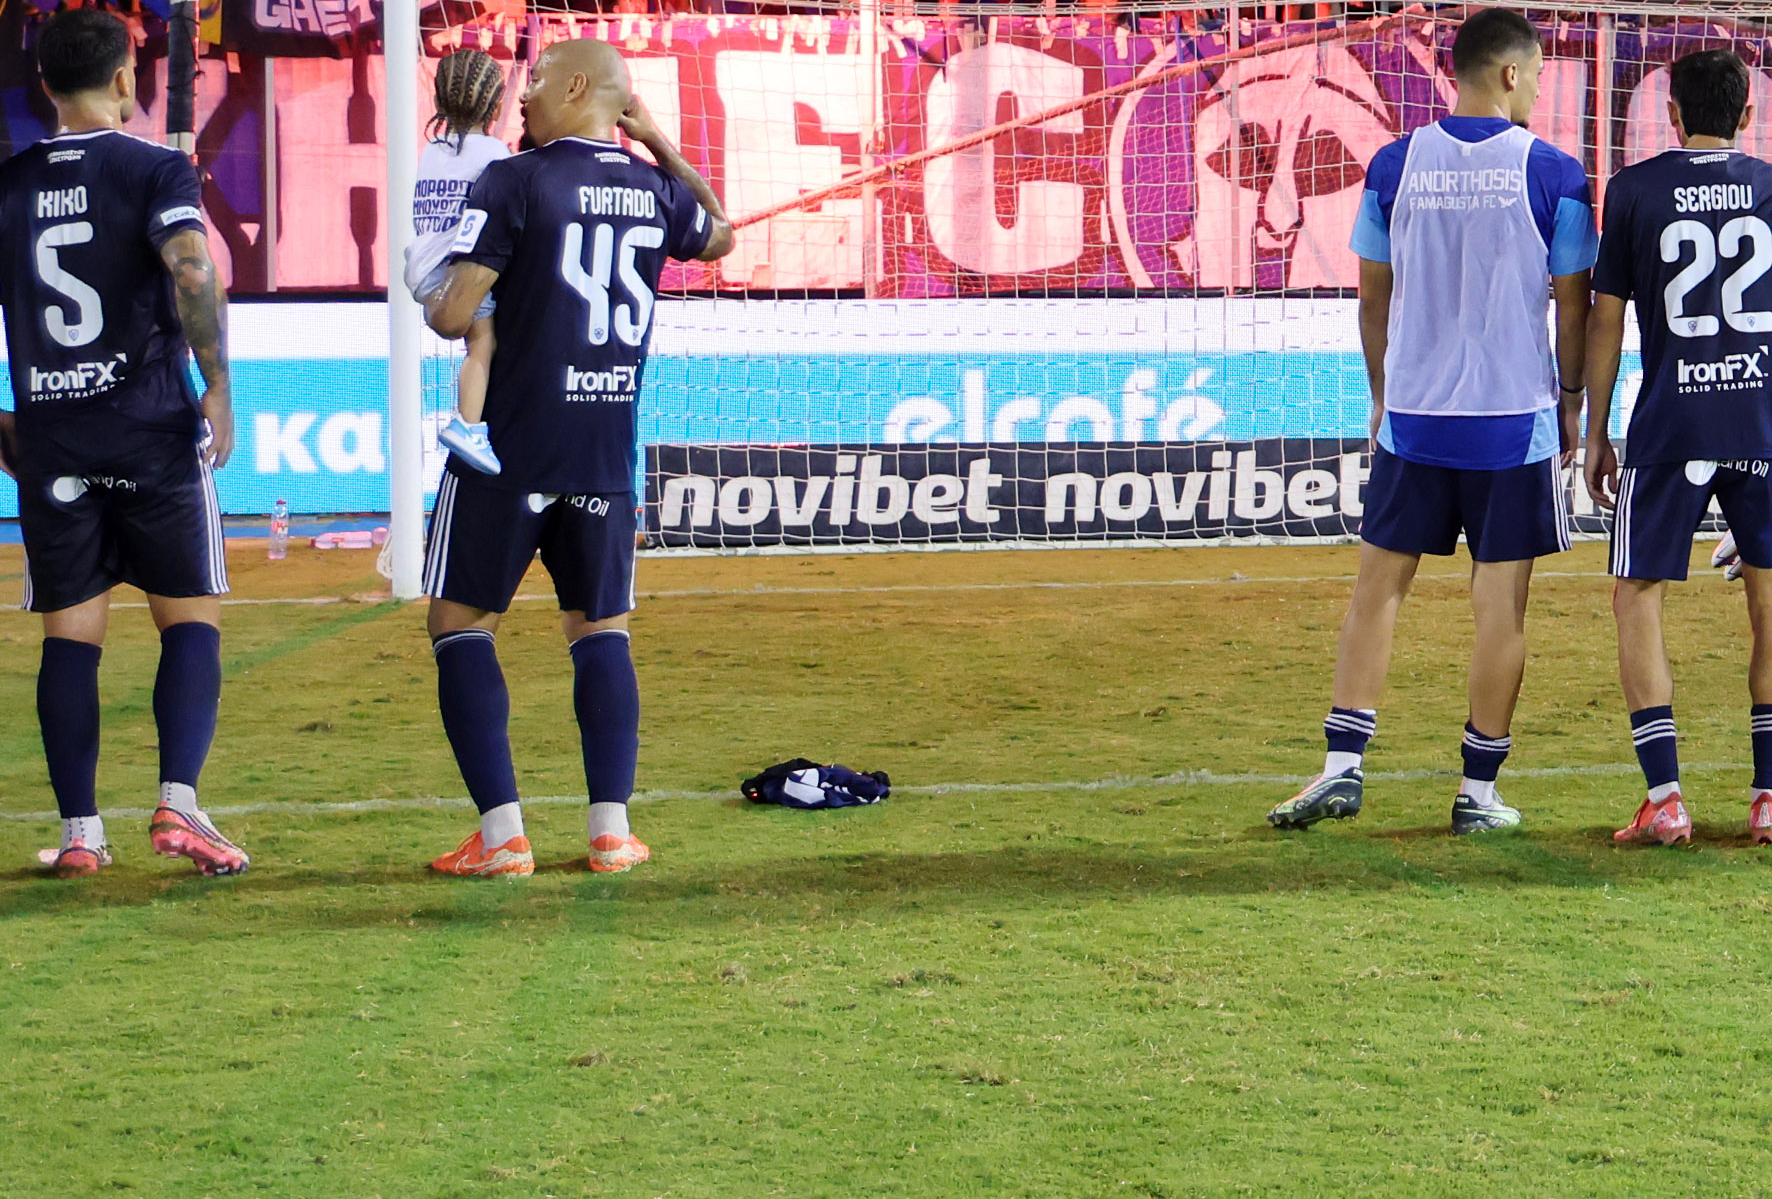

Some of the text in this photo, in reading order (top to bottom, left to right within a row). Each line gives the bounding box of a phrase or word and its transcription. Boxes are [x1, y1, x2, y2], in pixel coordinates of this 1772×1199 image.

[1408, 169, 1522, 193] ANORTHOSIS
[37, 185, 88, 218] KIKO
[579, 186, 655, 219] FURTADO
[1409, 195, 1496, 210] FAMAGUSTA FC
[1674, 183, 1753, 213] SERGIOU
[36, 221, 103, 347] 5
[561, 222, 664, 347] 45
[31, 361, 118, 392] IronFX
[566, 365, 638, 392] IronFX
[1677, 352, 1762, 384] IronFX
[31, 393, 63, 402] SOLID
[566, 394, 634, 402] SOLID TRADIN
[1678, 380, 1763, 394] SOLID TRADING
[1751, 459, 1769, 478] Oil
[659, 455, 1002, 527] novibet
[1045, 450, 1368, 523] novibet
[588, 497, 610, 517] Oil
